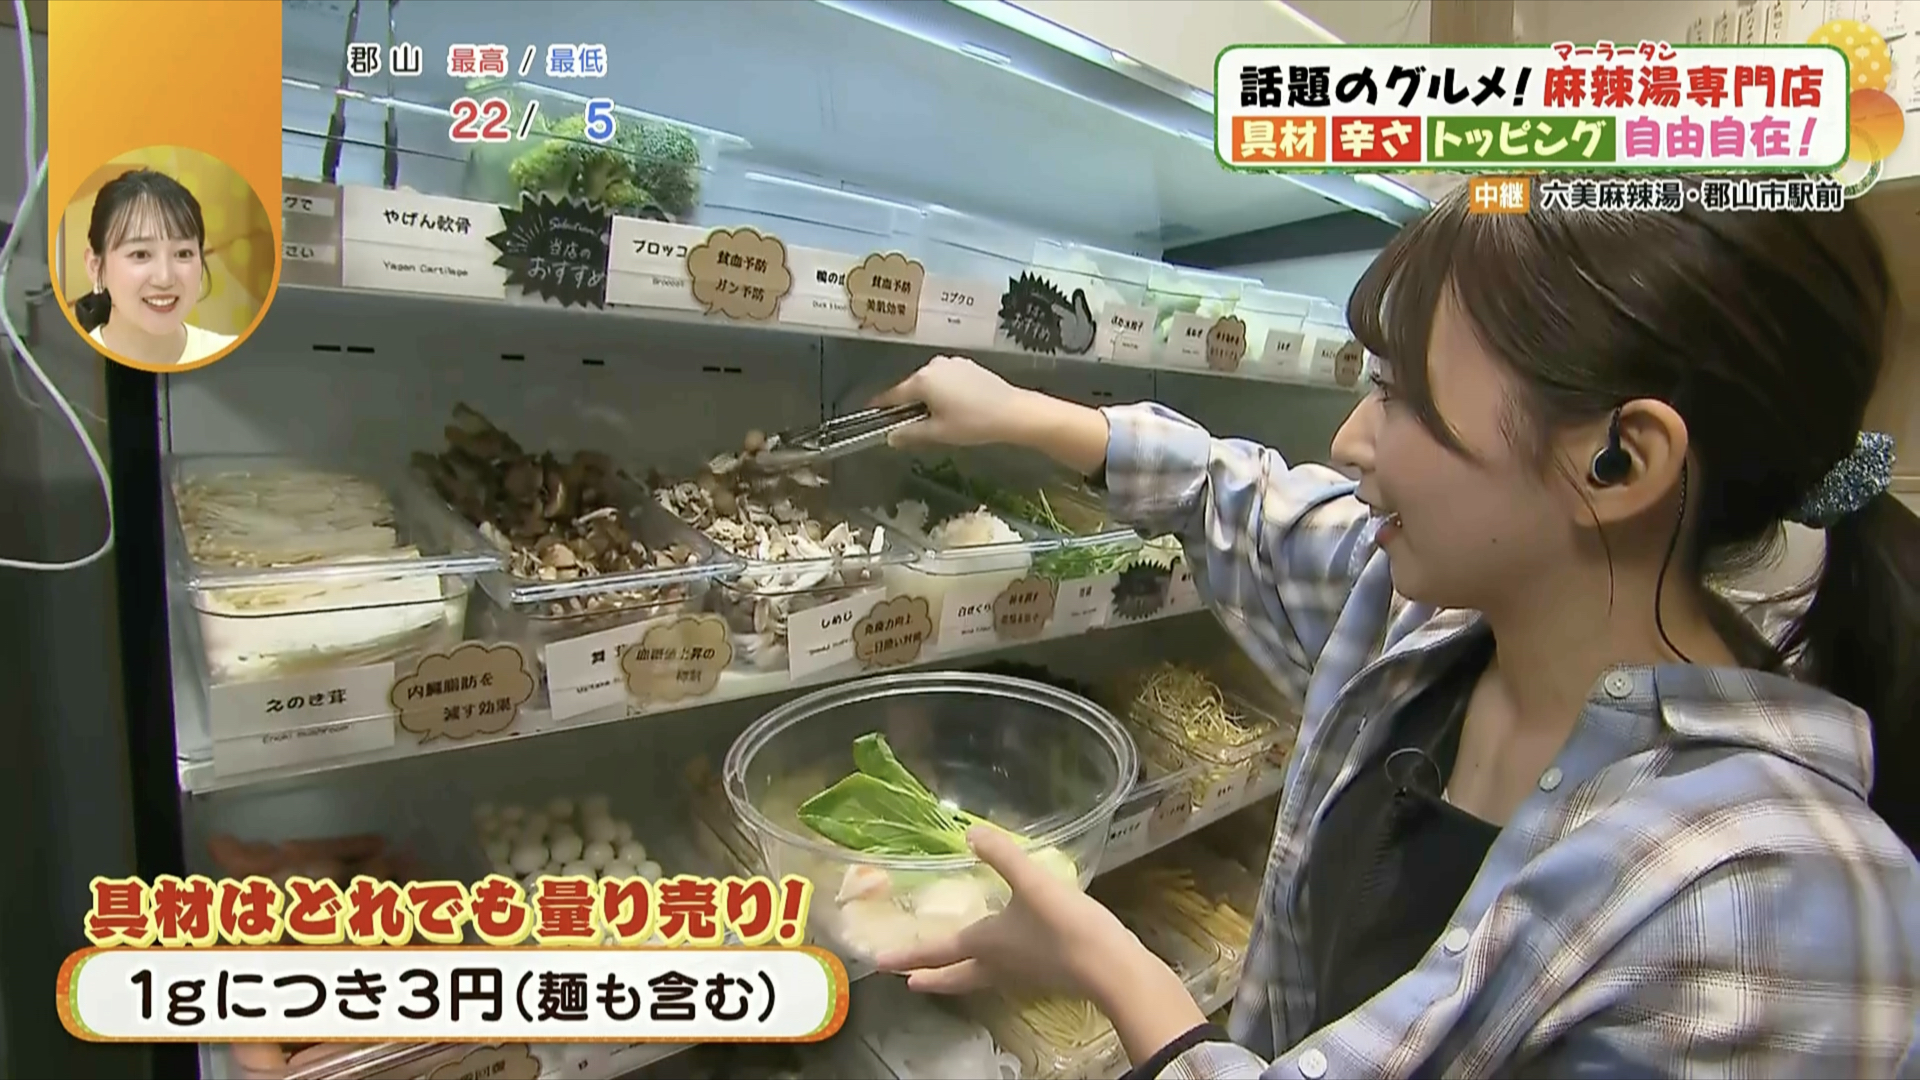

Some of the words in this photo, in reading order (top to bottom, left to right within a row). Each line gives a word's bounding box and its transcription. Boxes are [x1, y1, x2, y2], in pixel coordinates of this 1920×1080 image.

[383, 208, 471, 235] やげん軟骨
[550, 237, 591, 260] 当店の
[527, 255, 604, 289] おすすめ
[716, 250, 768, 274] 貧血予防
[715, 278, 765, 302] ガン予防
[871, 275, 912, 295] 貧血予防
[866, 298, 907, 316] 美肌効果
[820, 610, 853, 629] しめじ
[265, 687, 348, 714] えのき茸
